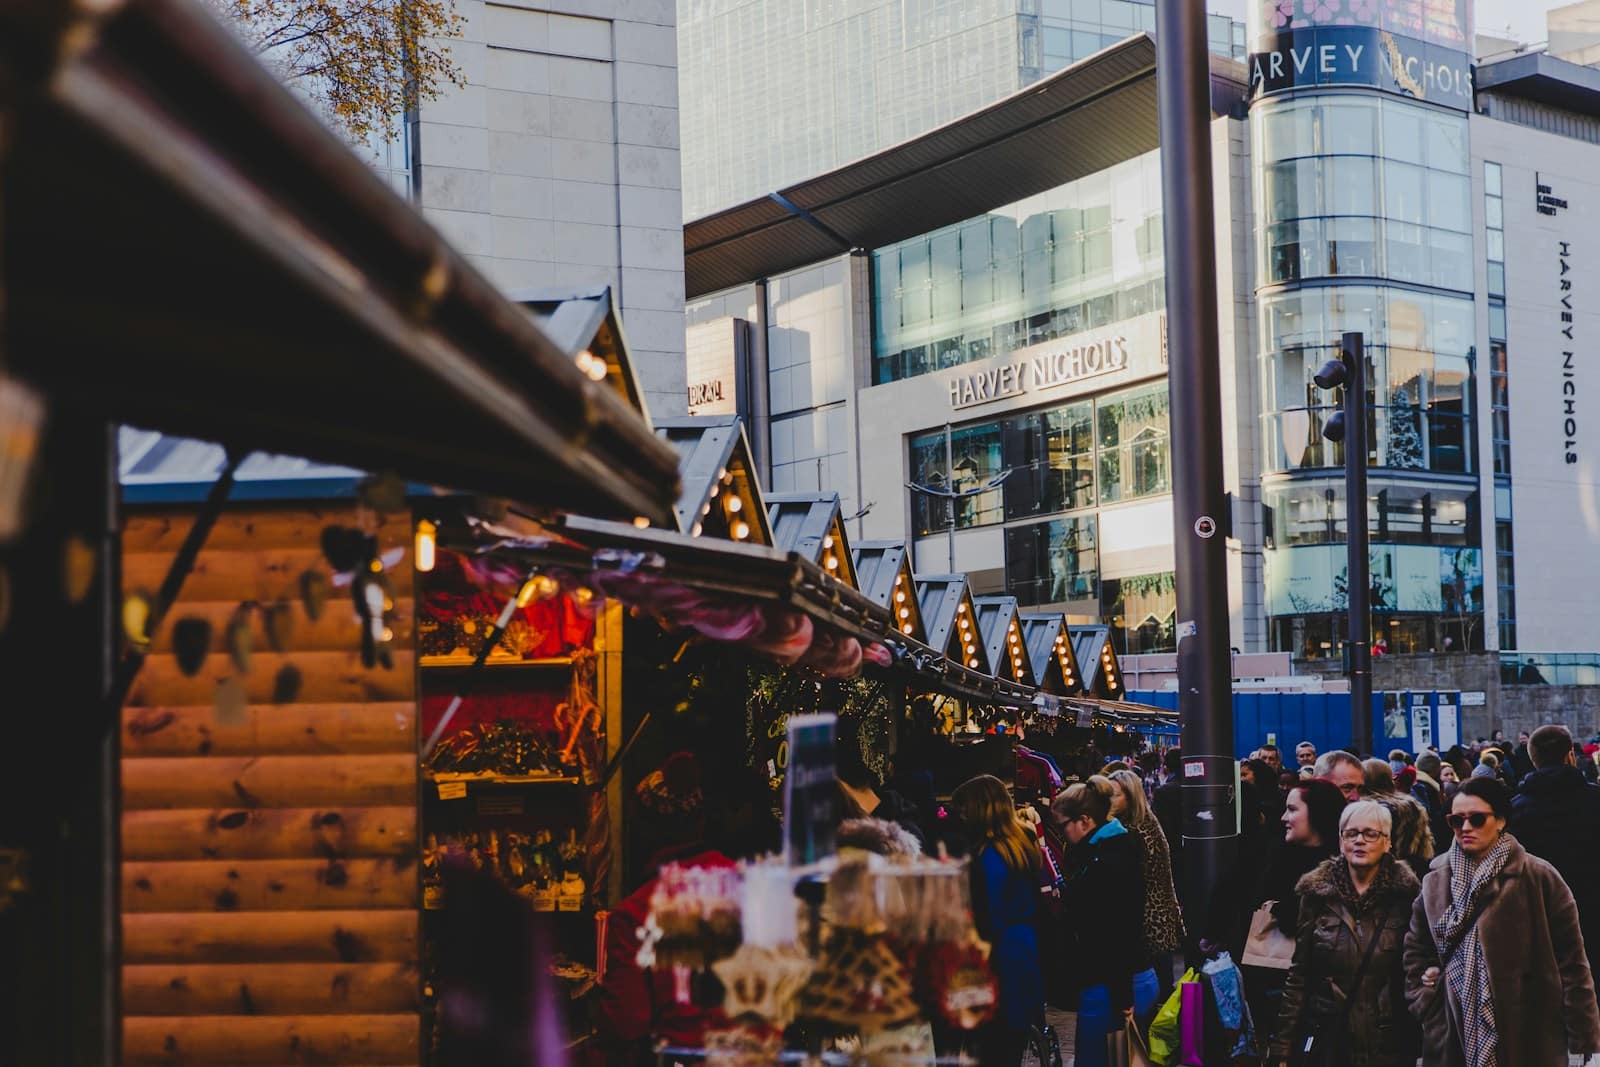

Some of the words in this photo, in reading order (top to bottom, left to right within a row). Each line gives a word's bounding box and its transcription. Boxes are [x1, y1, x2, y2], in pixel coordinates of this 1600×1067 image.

[1559, 241, 1574, 340] HARVEY
[949, 361, 1026, 405] HARVEY
[1032, 338, 1127, 384] NICHOLS
[1561, 351, 1577, 464] NICHOLS
